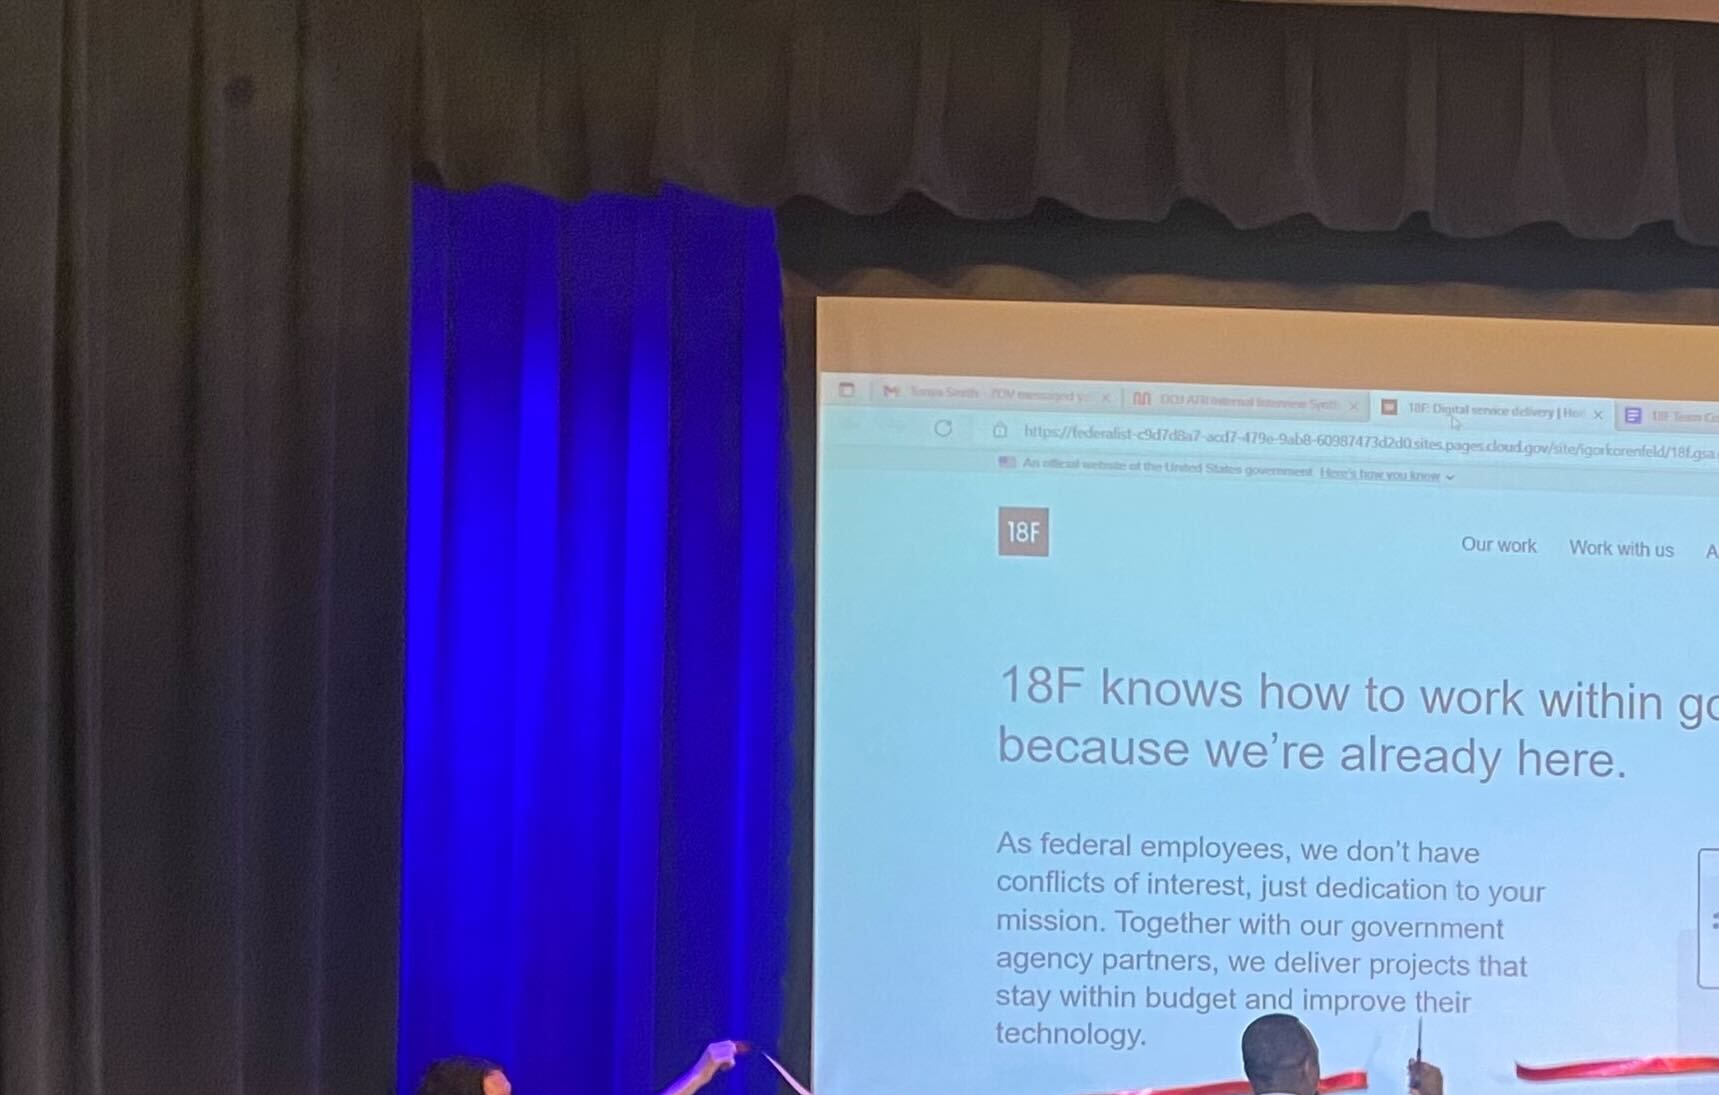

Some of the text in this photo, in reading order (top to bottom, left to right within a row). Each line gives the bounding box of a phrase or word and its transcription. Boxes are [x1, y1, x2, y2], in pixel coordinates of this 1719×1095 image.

[1433, 404, 1469, 417] Digital
[1472, 406, 1508, 416] service
[1513, 407, 1554, 420] delivery
[1007, 520, 1041, 543] 18F
[1462, 536, 1537, 553] Our work
[1570, 539, 1674, 557] Work with us
[1003, 665, 1084, 703] 18F
[1103, 667, 1242, 708] knows
[1261, 672, 1350, 711] how
[1365, 677, 1404, 712] to
[1420, 679, 1524, 716] work
[1539, 681, 1661, 720] within
[1000, 725, 1624, 783] because we're already here.
[997, 831, 1480, 864] As federal employees, we don't have
[997, 870, 1546, 907] conflicts of interest, just dedication to your
[997, 909, 1504, 942] mission. Together with our government
[997, 950, 1528, 980] agency partners, we deliver projects that
[996, 985, 1472, 1016] stay within budget and improve their
[996, 1021, 1145, 1050] technology.
